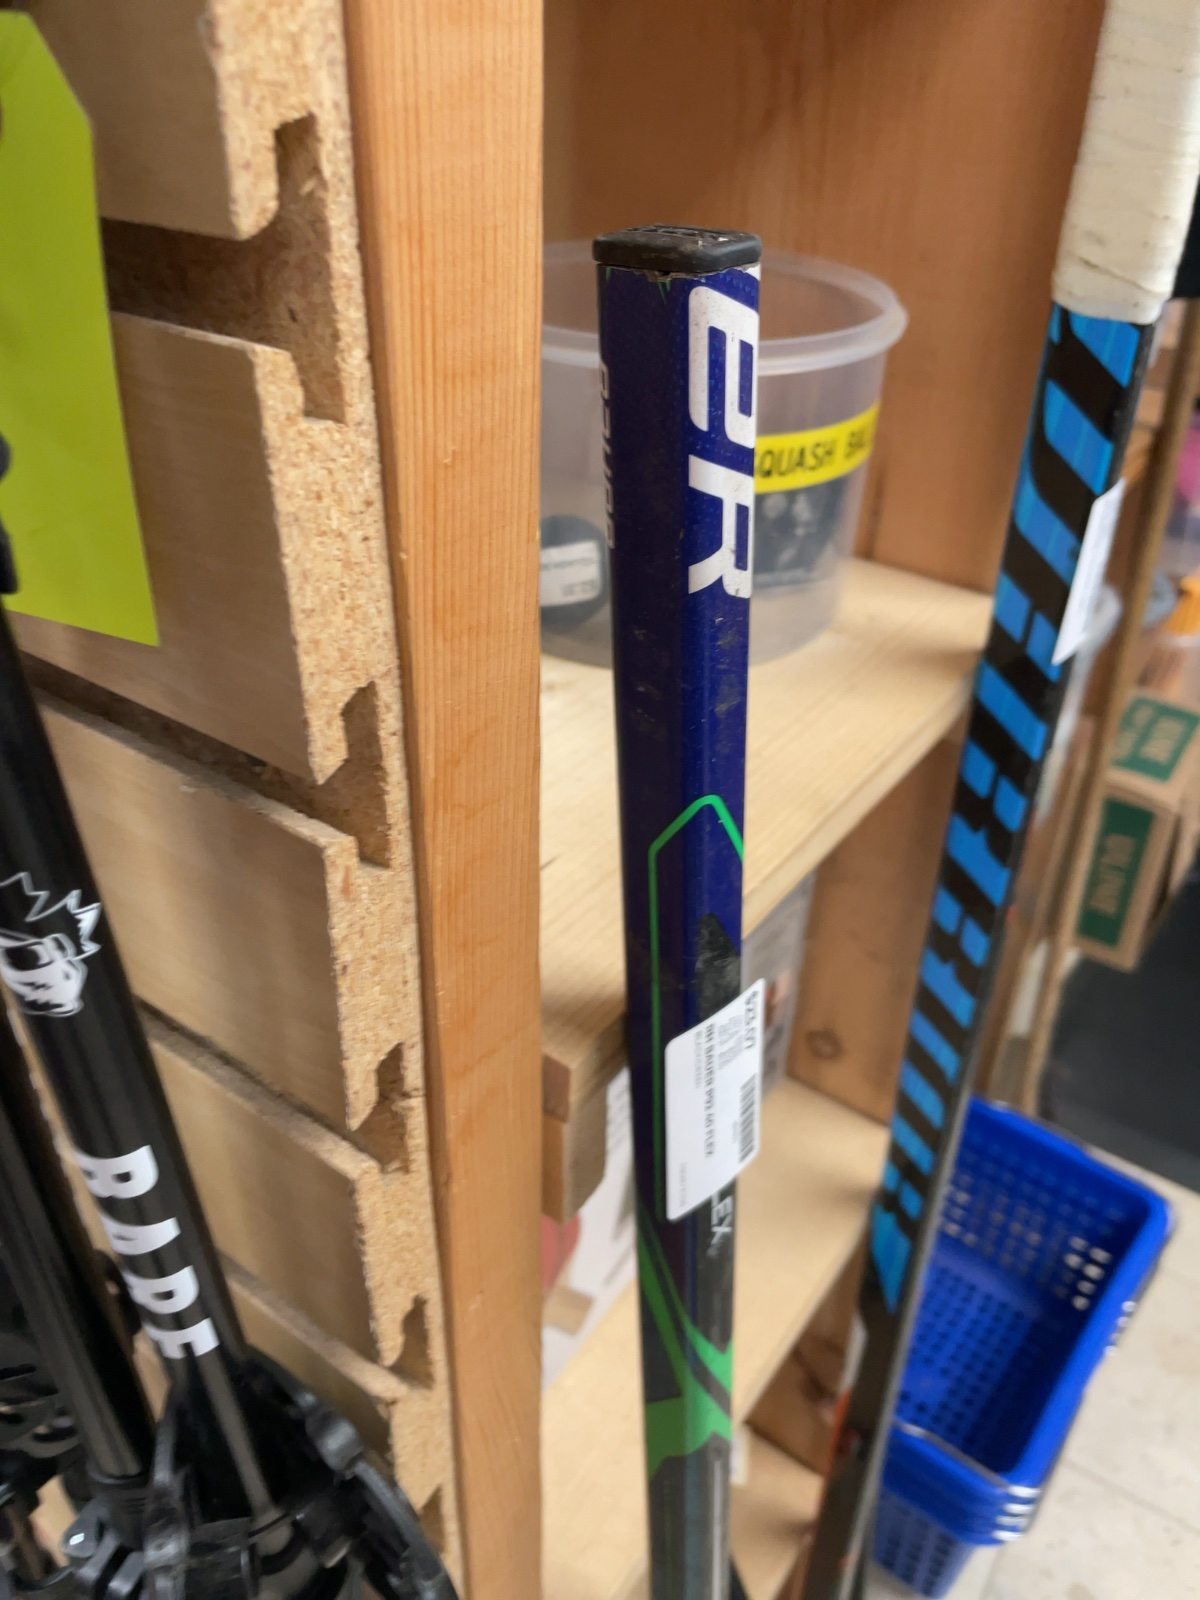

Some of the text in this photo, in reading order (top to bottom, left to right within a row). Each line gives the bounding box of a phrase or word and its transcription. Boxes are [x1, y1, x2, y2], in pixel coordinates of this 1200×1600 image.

[757, 440, 838, 478] QUASH
[705, 1044, 715, 1086] BAUER
[705, 1128, 715, 1158] FLEX
